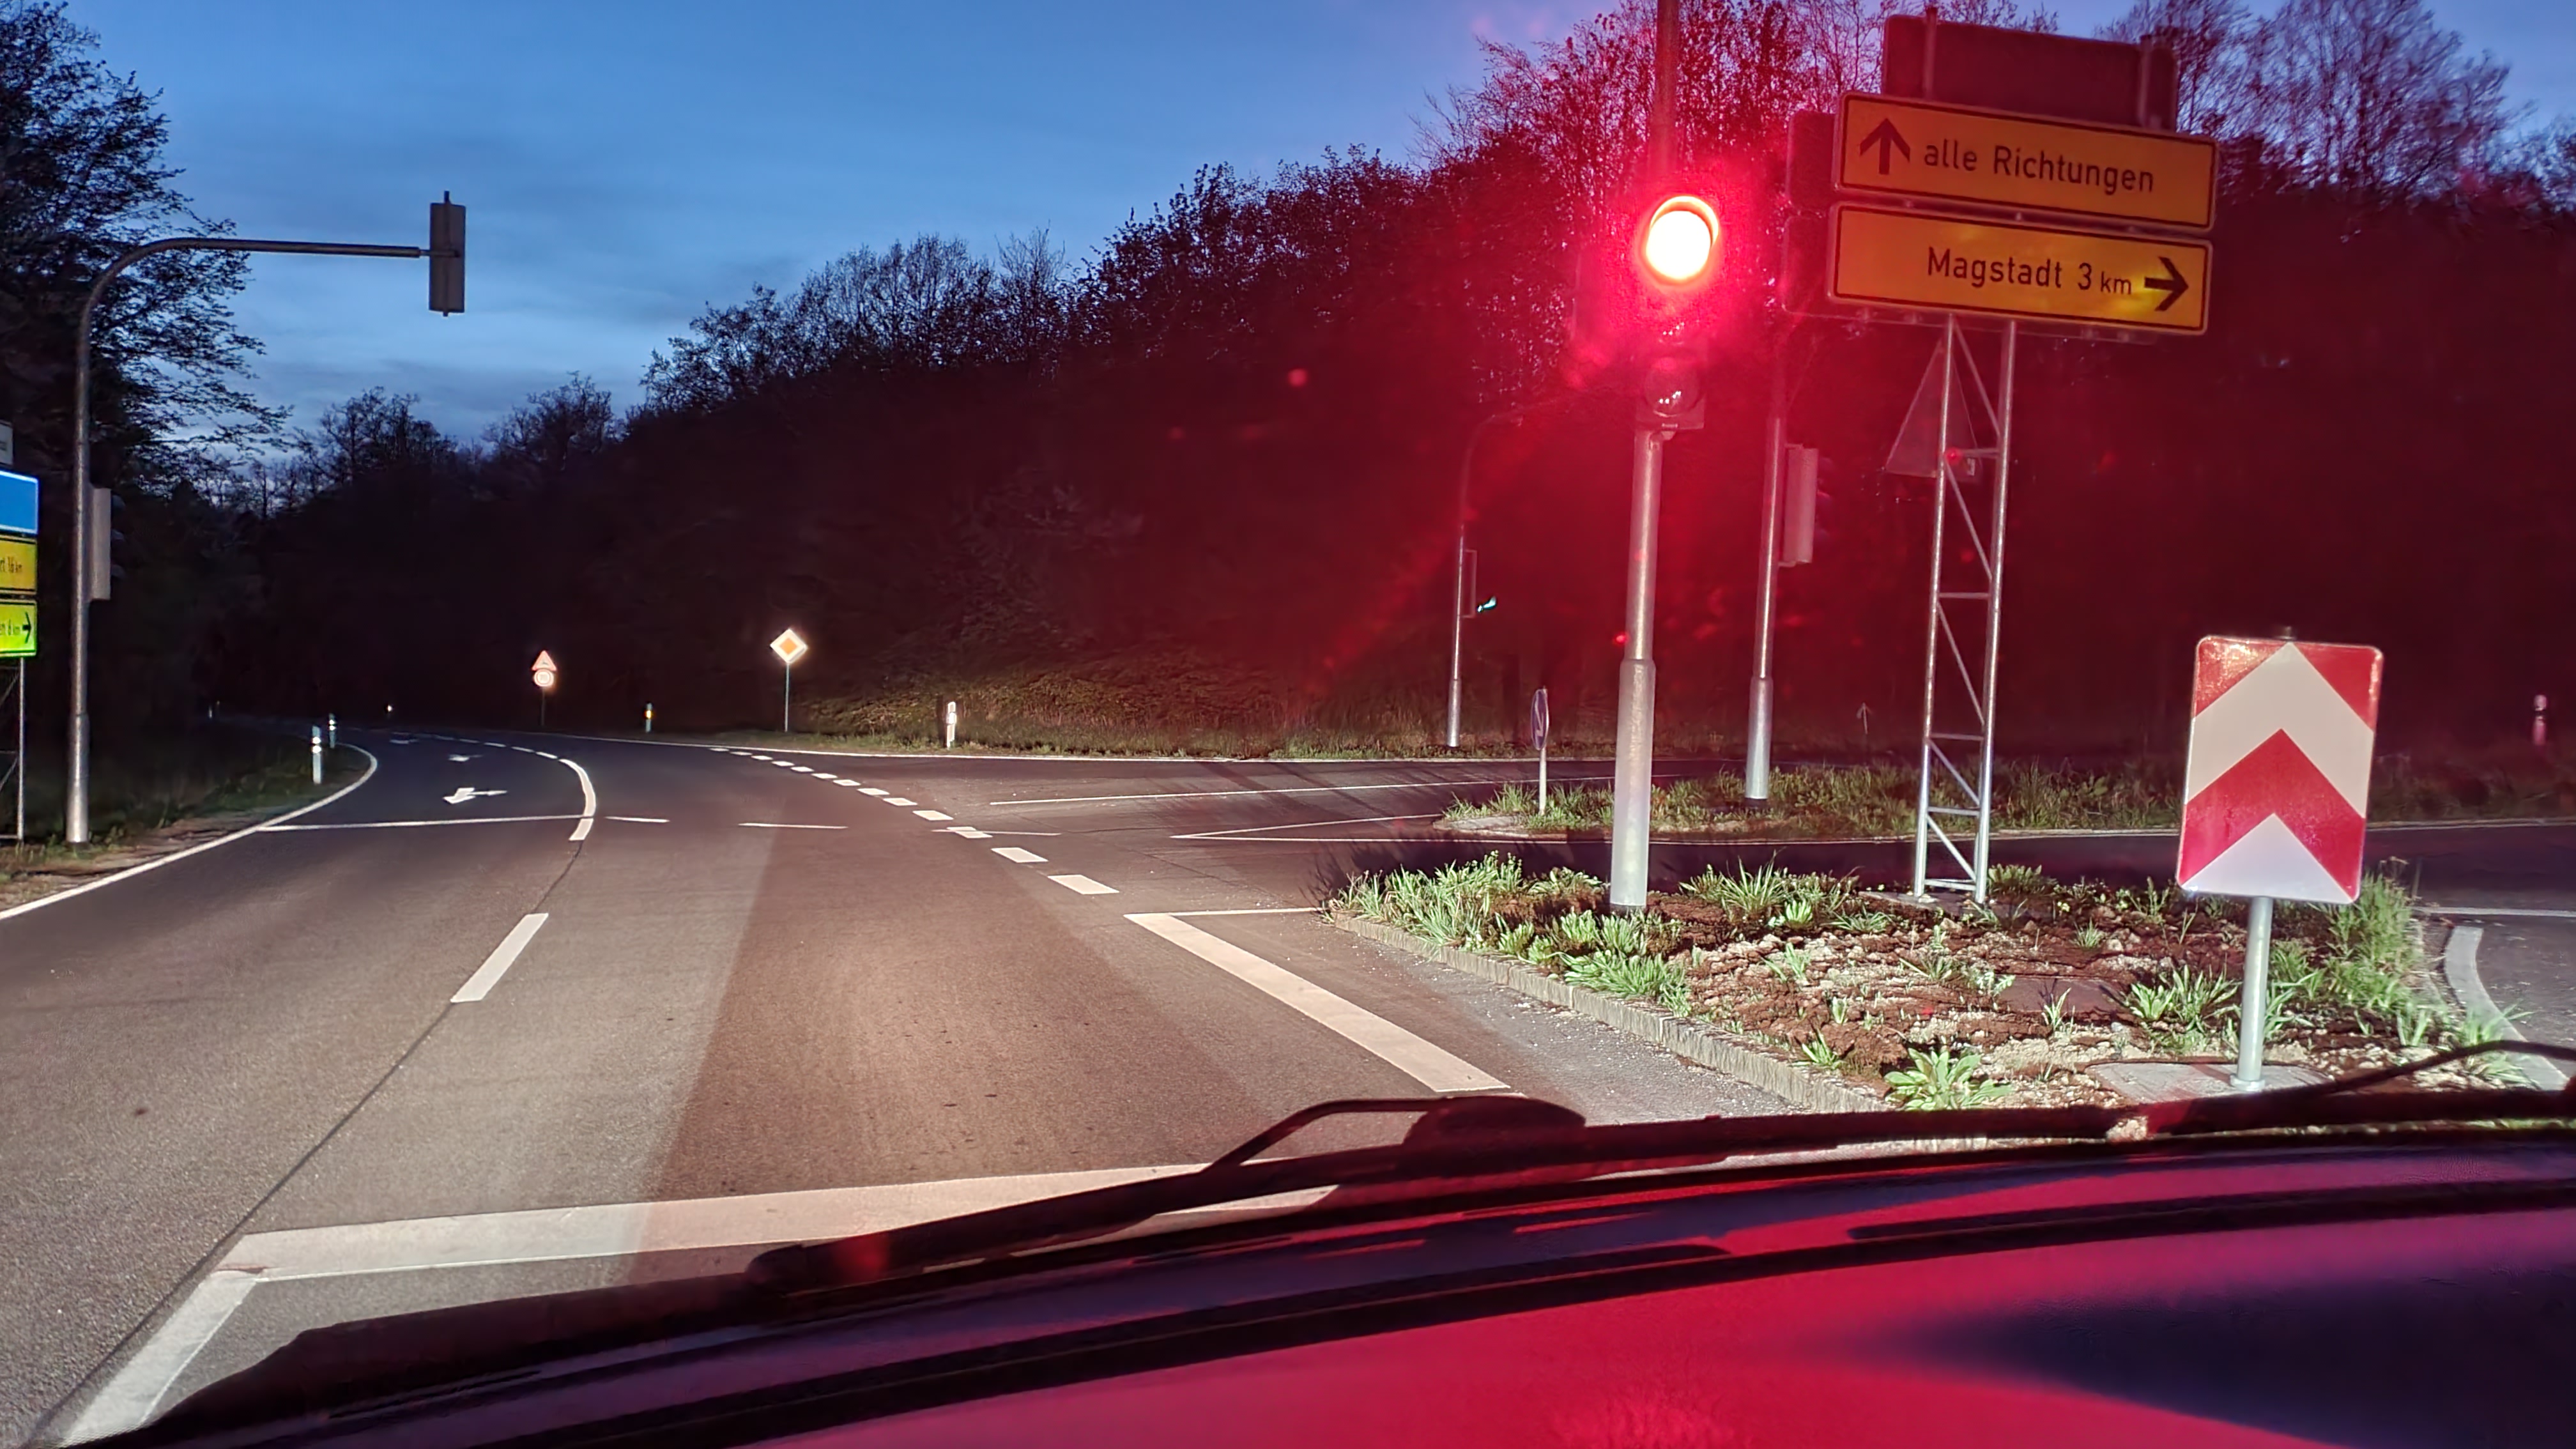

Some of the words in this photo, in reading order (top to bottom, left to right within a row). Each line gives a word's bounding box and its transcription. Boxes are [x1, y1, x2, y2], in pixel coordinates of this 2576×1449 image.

[1924, 139, 1978, 171] alle
[1993, 144, 2154, 195] Richtungen
[1928, 247, 2062, 289] Magstadt
[2078, 262, 2092, 291] 3
[2100, 271, 2132, 295] km
